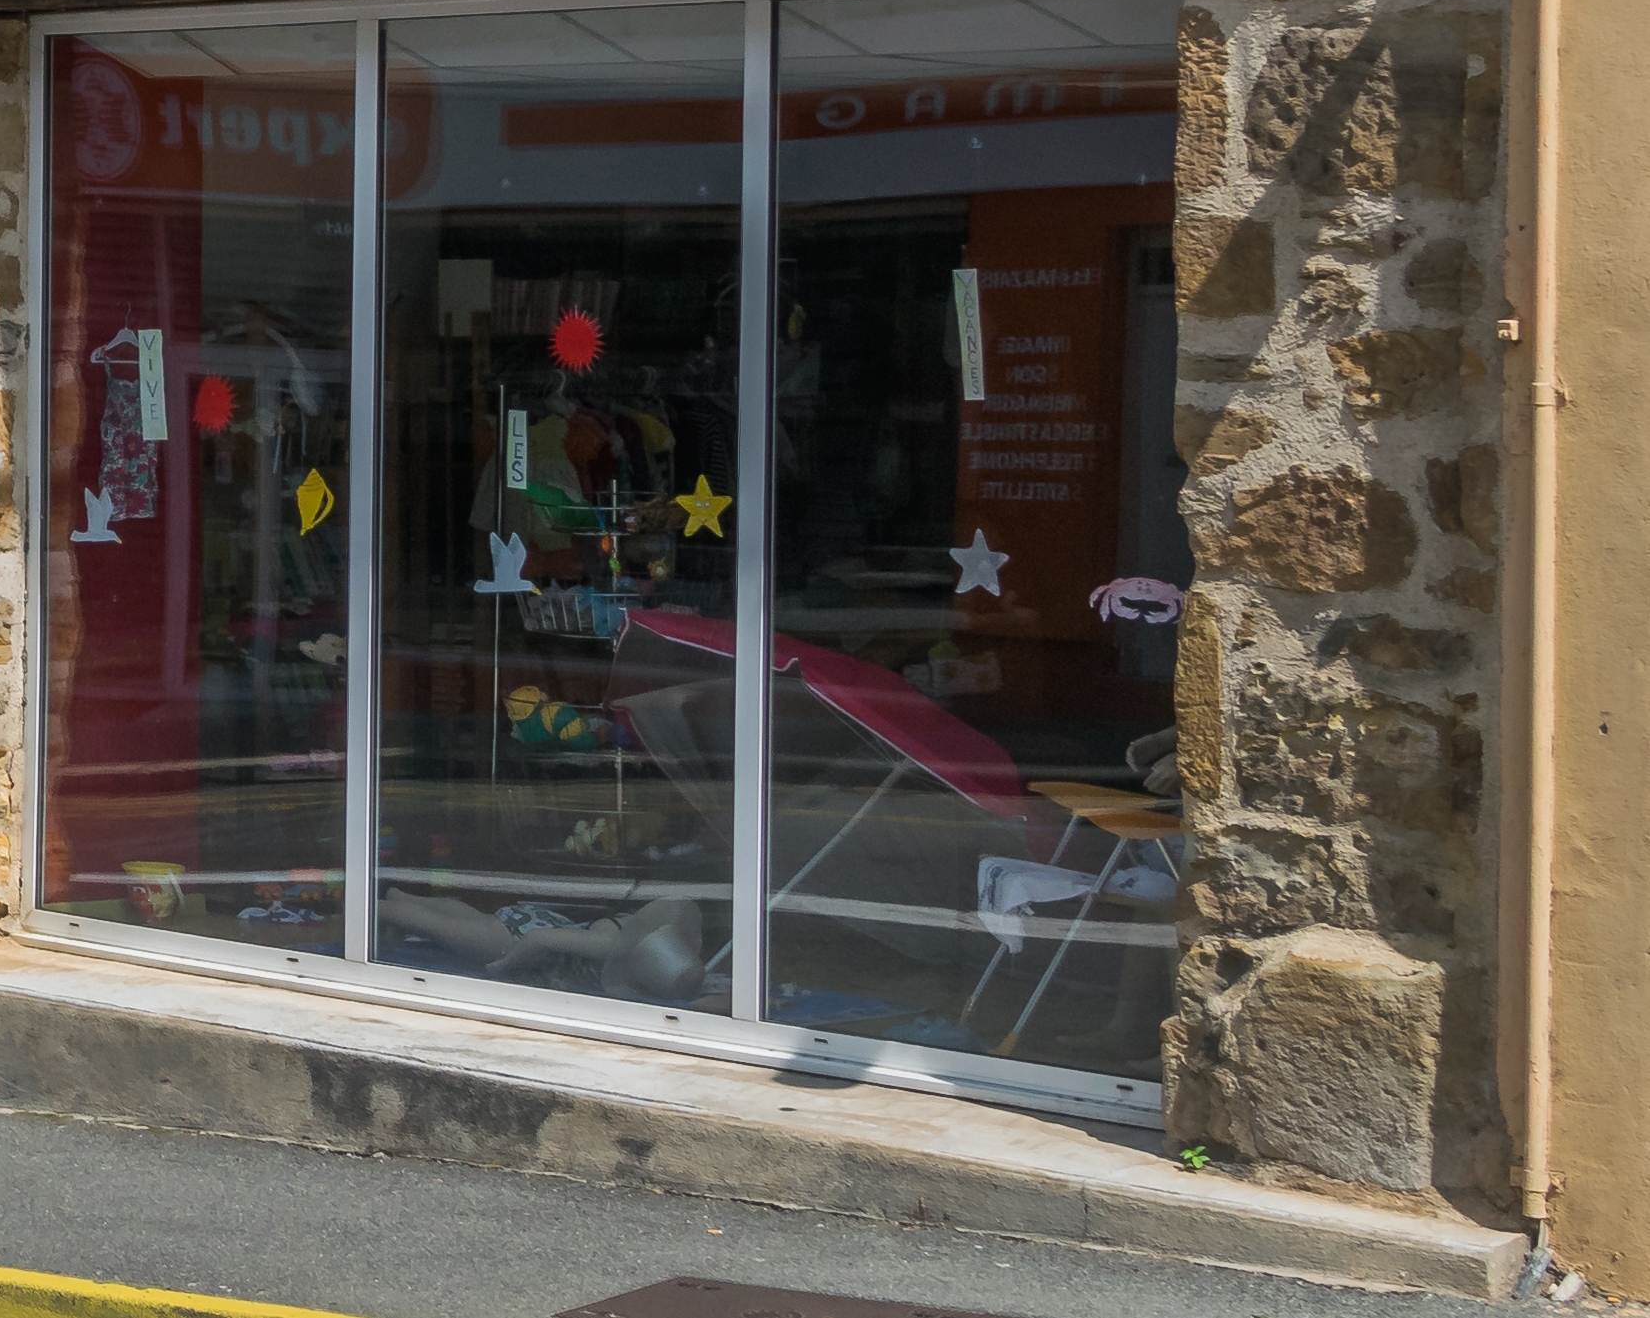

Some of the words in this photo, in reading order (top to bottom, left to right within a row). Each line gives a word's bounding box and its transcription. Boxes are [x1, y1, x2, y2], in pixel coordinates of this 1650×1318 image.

[955, 271, 980, 396] VACANCES
[142, 334, 159, 420] VIVE
[511, 415, 524, 483] LES
